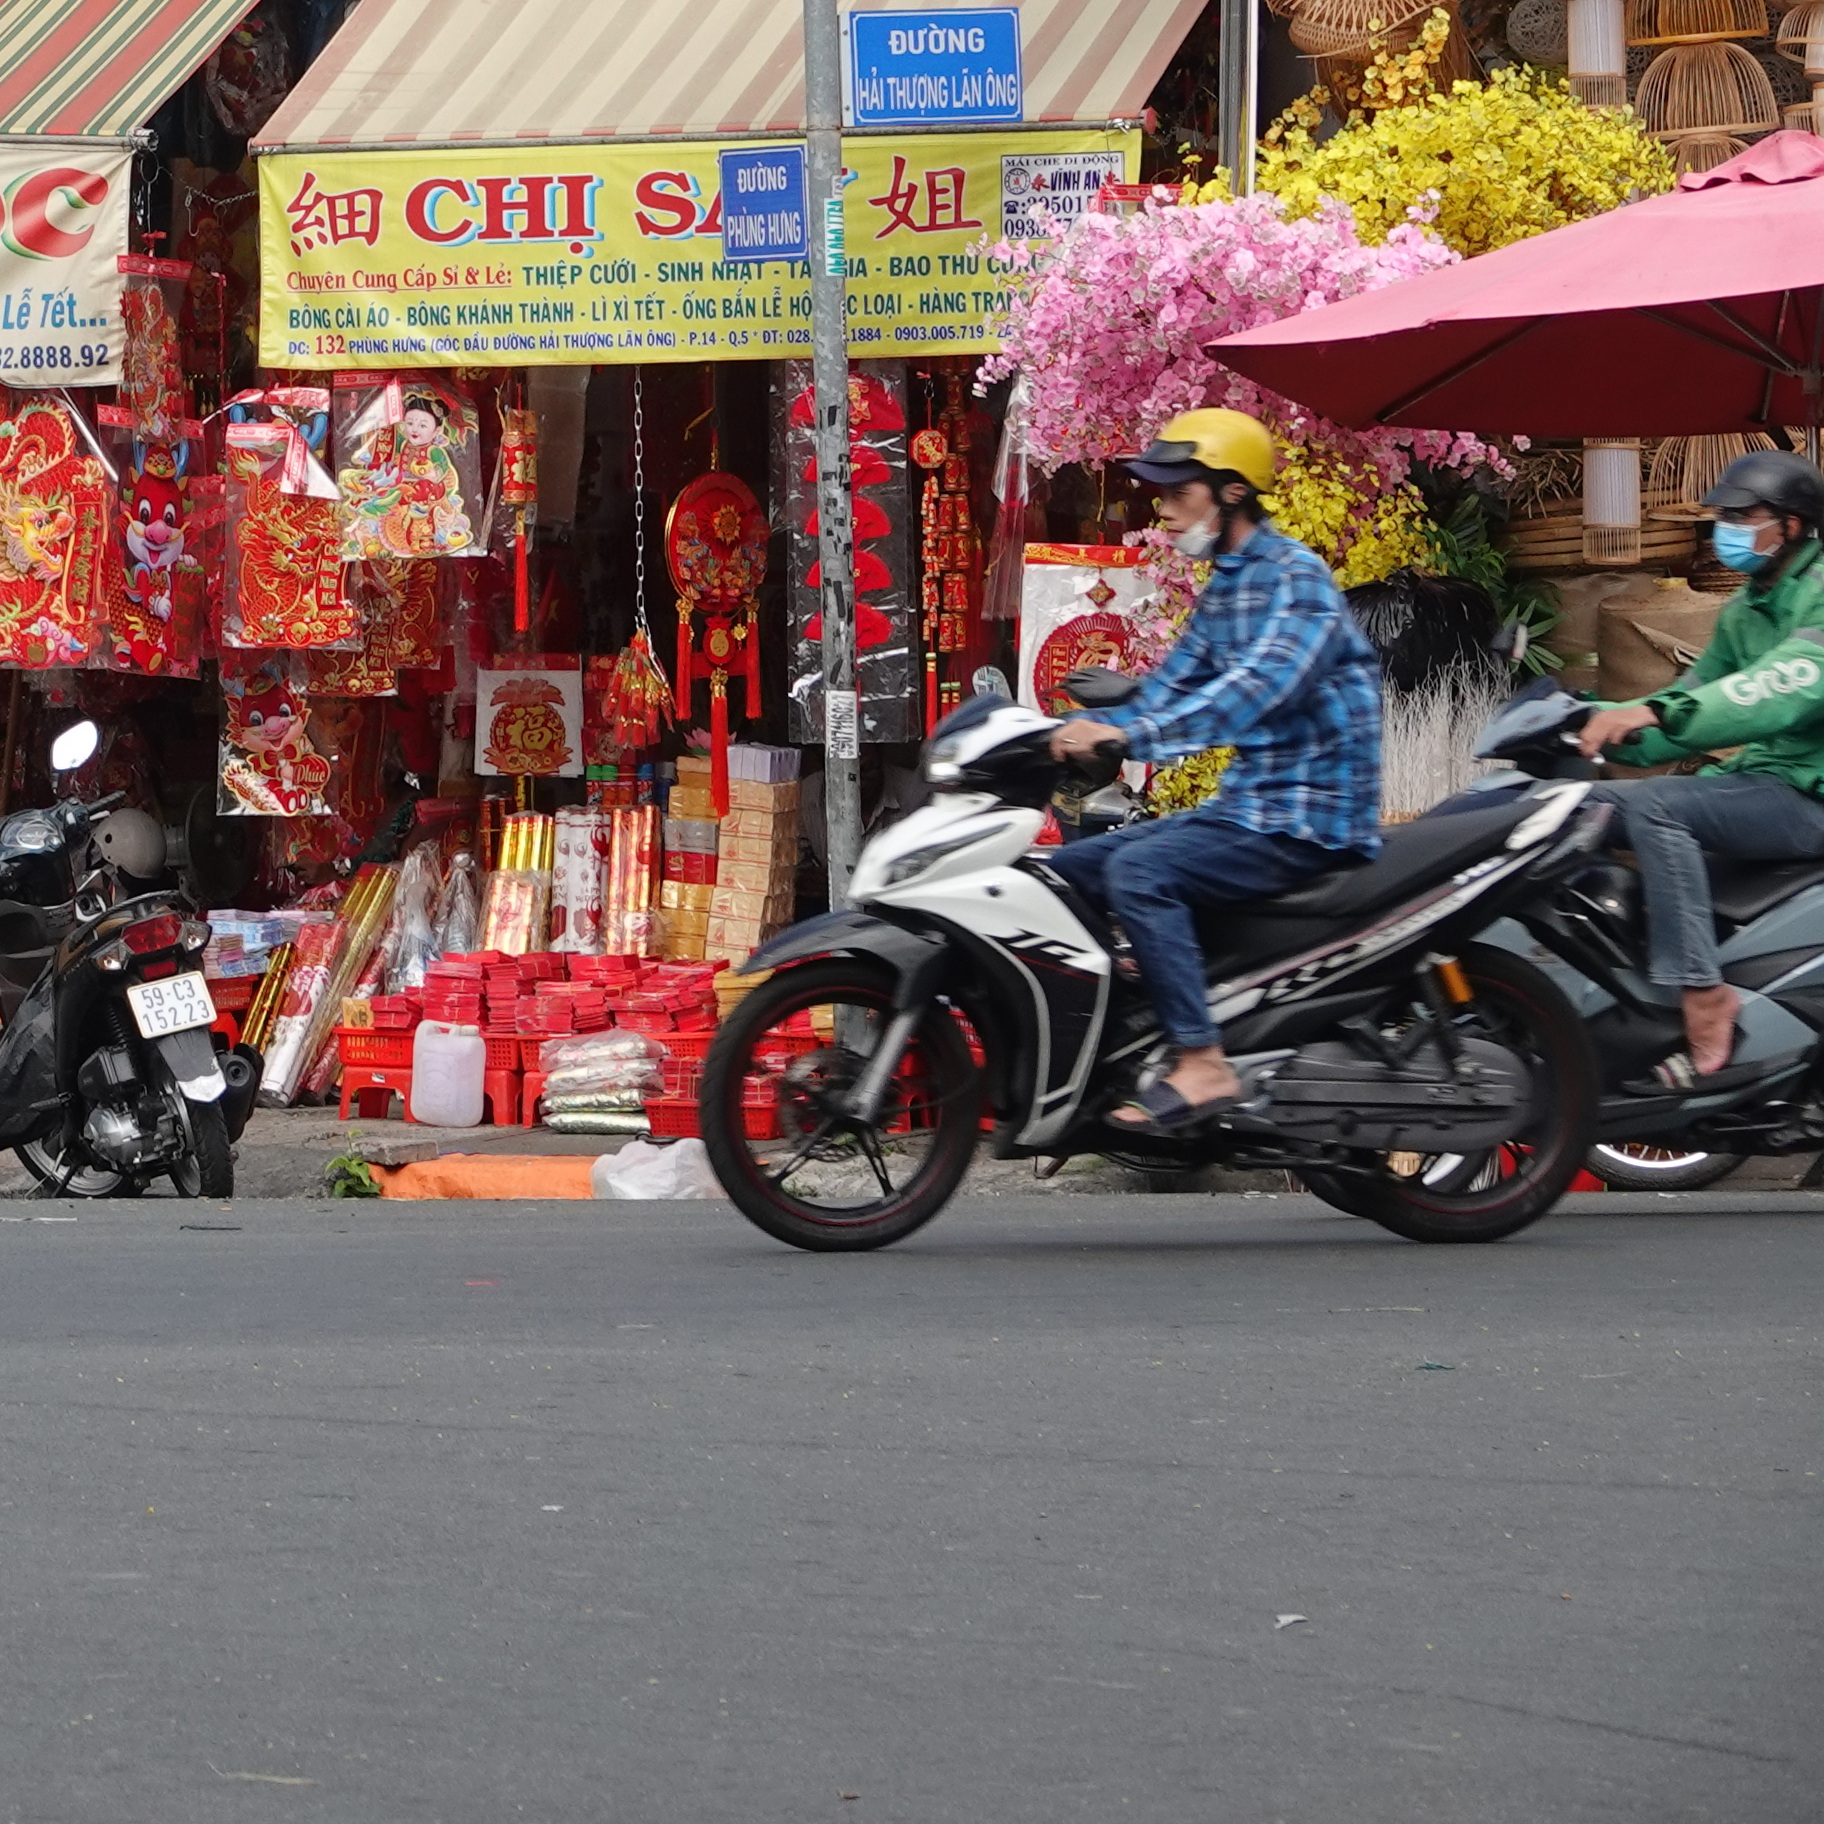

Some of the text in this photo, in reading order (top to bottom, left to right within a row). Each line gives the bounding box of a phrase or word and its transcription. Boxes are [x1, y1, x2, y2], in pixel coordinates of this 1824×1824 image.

[888, 23, 985, 55] ĐƯỜNG
[859, 66, 1017, 116] HẢI THƯỢNG LÃN ÔNG
[737, 160, 787, 194] ĐƯỜNG
[1034, 156, 1060, 167] CHE
[405, 174, 603, 259] CHỊ
[727, 210, 801, 249] PHÙNG HƯNG
[287, 271, 346, 295] Chuyên
[352, 270, 397, 293] Cung
[404, 264, 437, 293] Cấp
[523, 260, 583, 289] THIỆP
[589, 259, 637, 284] CƯỚI
[657, 263, 705, 282] SINH
[890, 256, 930, 277] BAO
[3, 286, 31, 330] Lễ
[290, 285, 965, 329] BÔNG CÀI ÁO BÔNG KHÁNH THÀNH LÌ XÌ TẾT LOẠI HÀNG
[315, 325, 984, 355] 132 PHÙNG HƯNG (GÓC ĐẦU ĐƯỜNG HẢI THƯỢNG LÃN ÔNG) P.14 0903.005.719
[1720, 658, 1821, 706] Grab
[141, 979, 196, 1009] 59-C3
[143, 999, 210, 1032] 152.23
